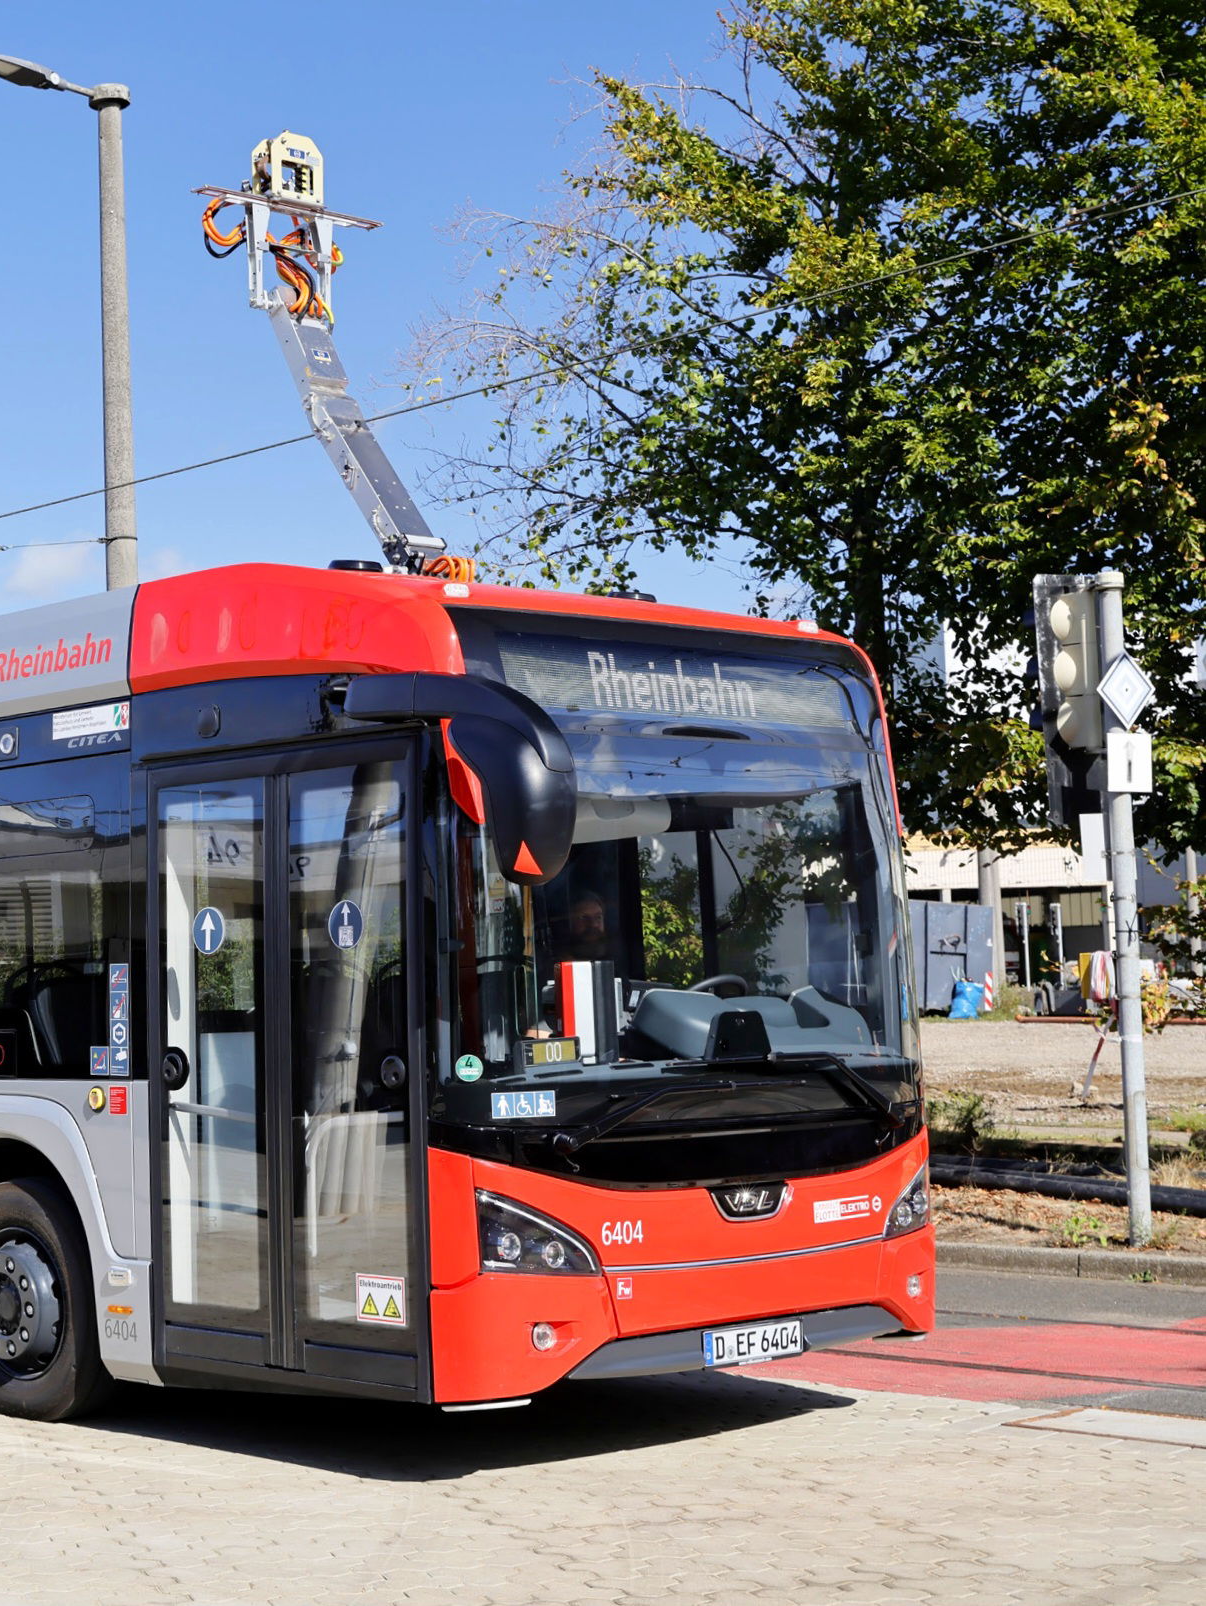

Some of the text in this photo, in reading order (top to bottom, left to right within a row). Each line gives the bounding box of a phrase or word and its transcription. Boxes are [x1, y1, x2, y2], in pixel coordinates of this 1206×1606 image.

[587, 651, 757, 717] Rheinbahn
[67, 731, 122, 749] CITEA
[464, 1056, 473, 1069] 4
[724, 1190, 774, 1212] VDL
[840, 1200, 870, 1214] ELEKTRO
[601, 1219, 644, 1246] 6404
[359, 1279, 402, 1291] Elektroantrieb
[618, 1281, 631, 1296] Fw
[104, 1318, 138, 1343] 6404
[715, 1325, 798, 1360] D EF 6404
